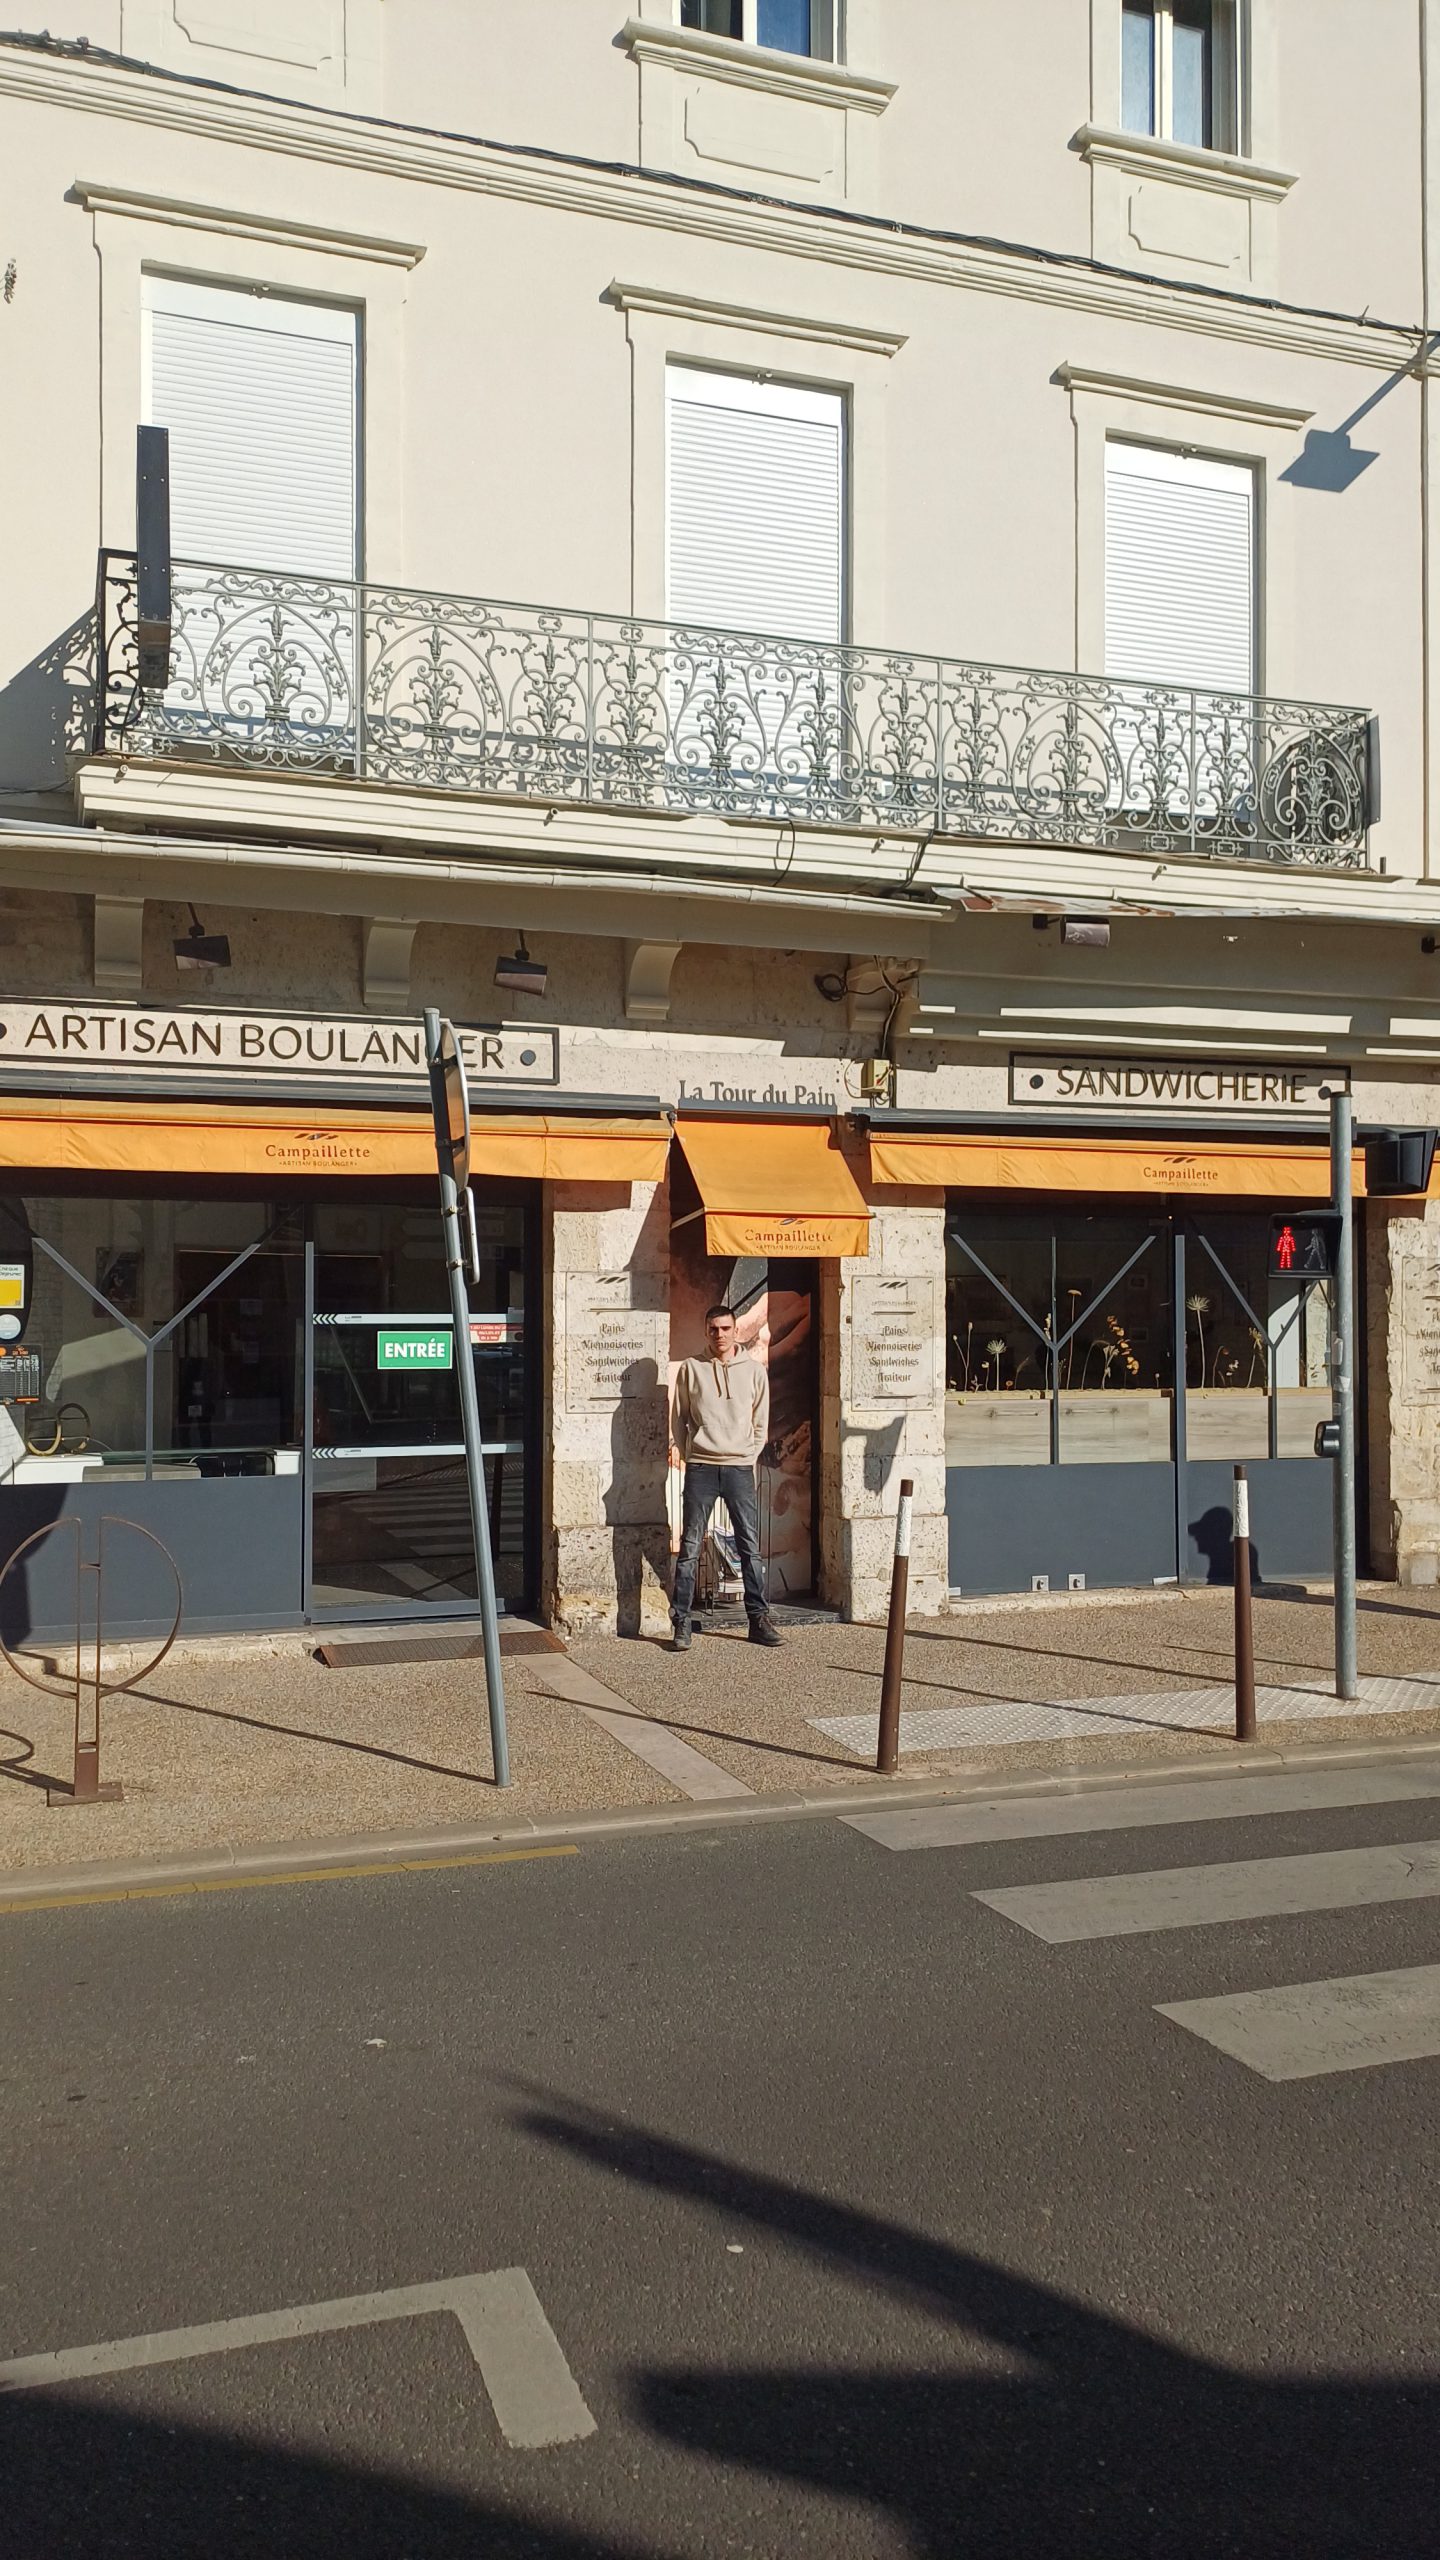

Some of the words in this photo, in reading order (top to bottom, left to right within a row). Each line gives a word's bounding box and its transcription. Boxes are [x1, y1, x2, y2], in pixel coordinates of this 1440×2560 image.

[25, 1013, 221, 1056] ARTISAN
[240, 1024, 504, 1069] BOULANER
[679, 1080, 703, 1100] La
[710, 1081, 756, 1103] Tour
[763, 1084, 787, 1105] du
[795, 1085, 836, 1106] Pain
[1057, 1065, 1307, 1103] SANDWICHERIE
[265, 1144, 371, 1160] Campaillette
[1143, 1167, 1219, 1181] Campaillette
[600, 1323, 625, 1335] Pains
[384, 1338, 446, 1359] ENTRÉE
[582, 1340, 644, 1350] Viennoiseries
